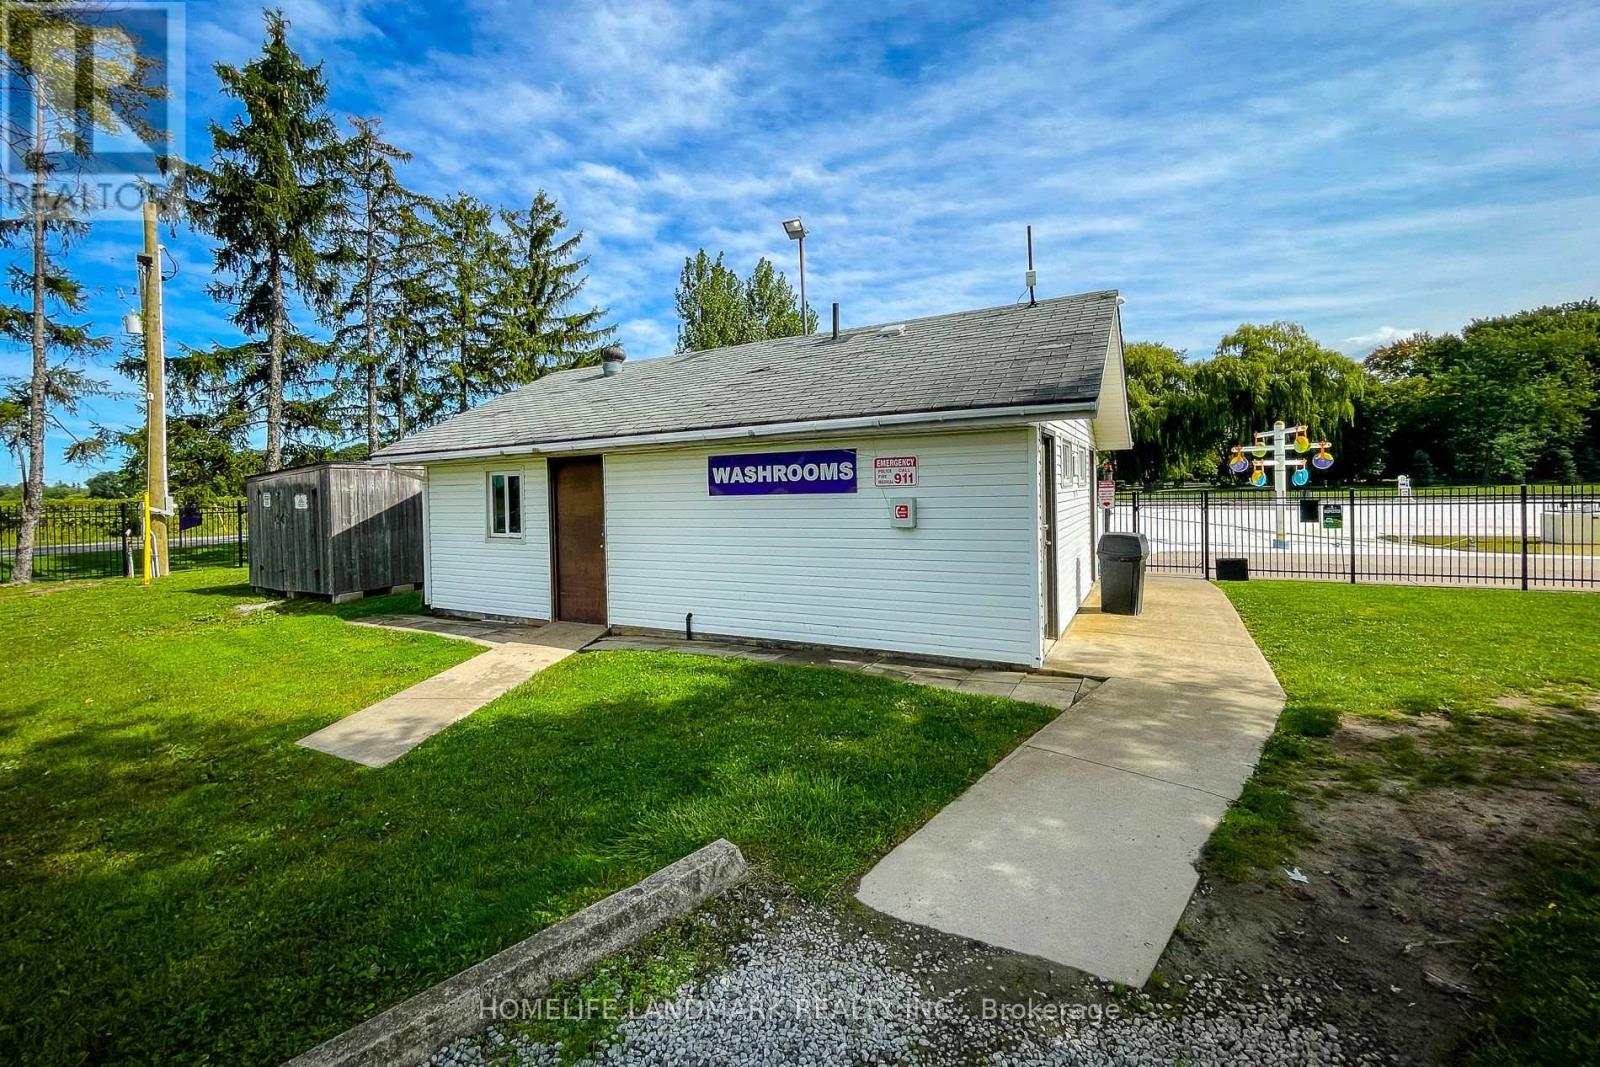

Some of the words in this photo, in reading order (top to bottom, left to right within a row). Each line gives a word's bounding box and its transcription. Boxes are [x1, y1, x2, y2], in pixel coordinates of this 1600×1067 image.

[876, 459, 914, 467] EMERGENCY
[712, 462, 854, 484] WASHROOMS
[894, 473, 913, 484] 911
